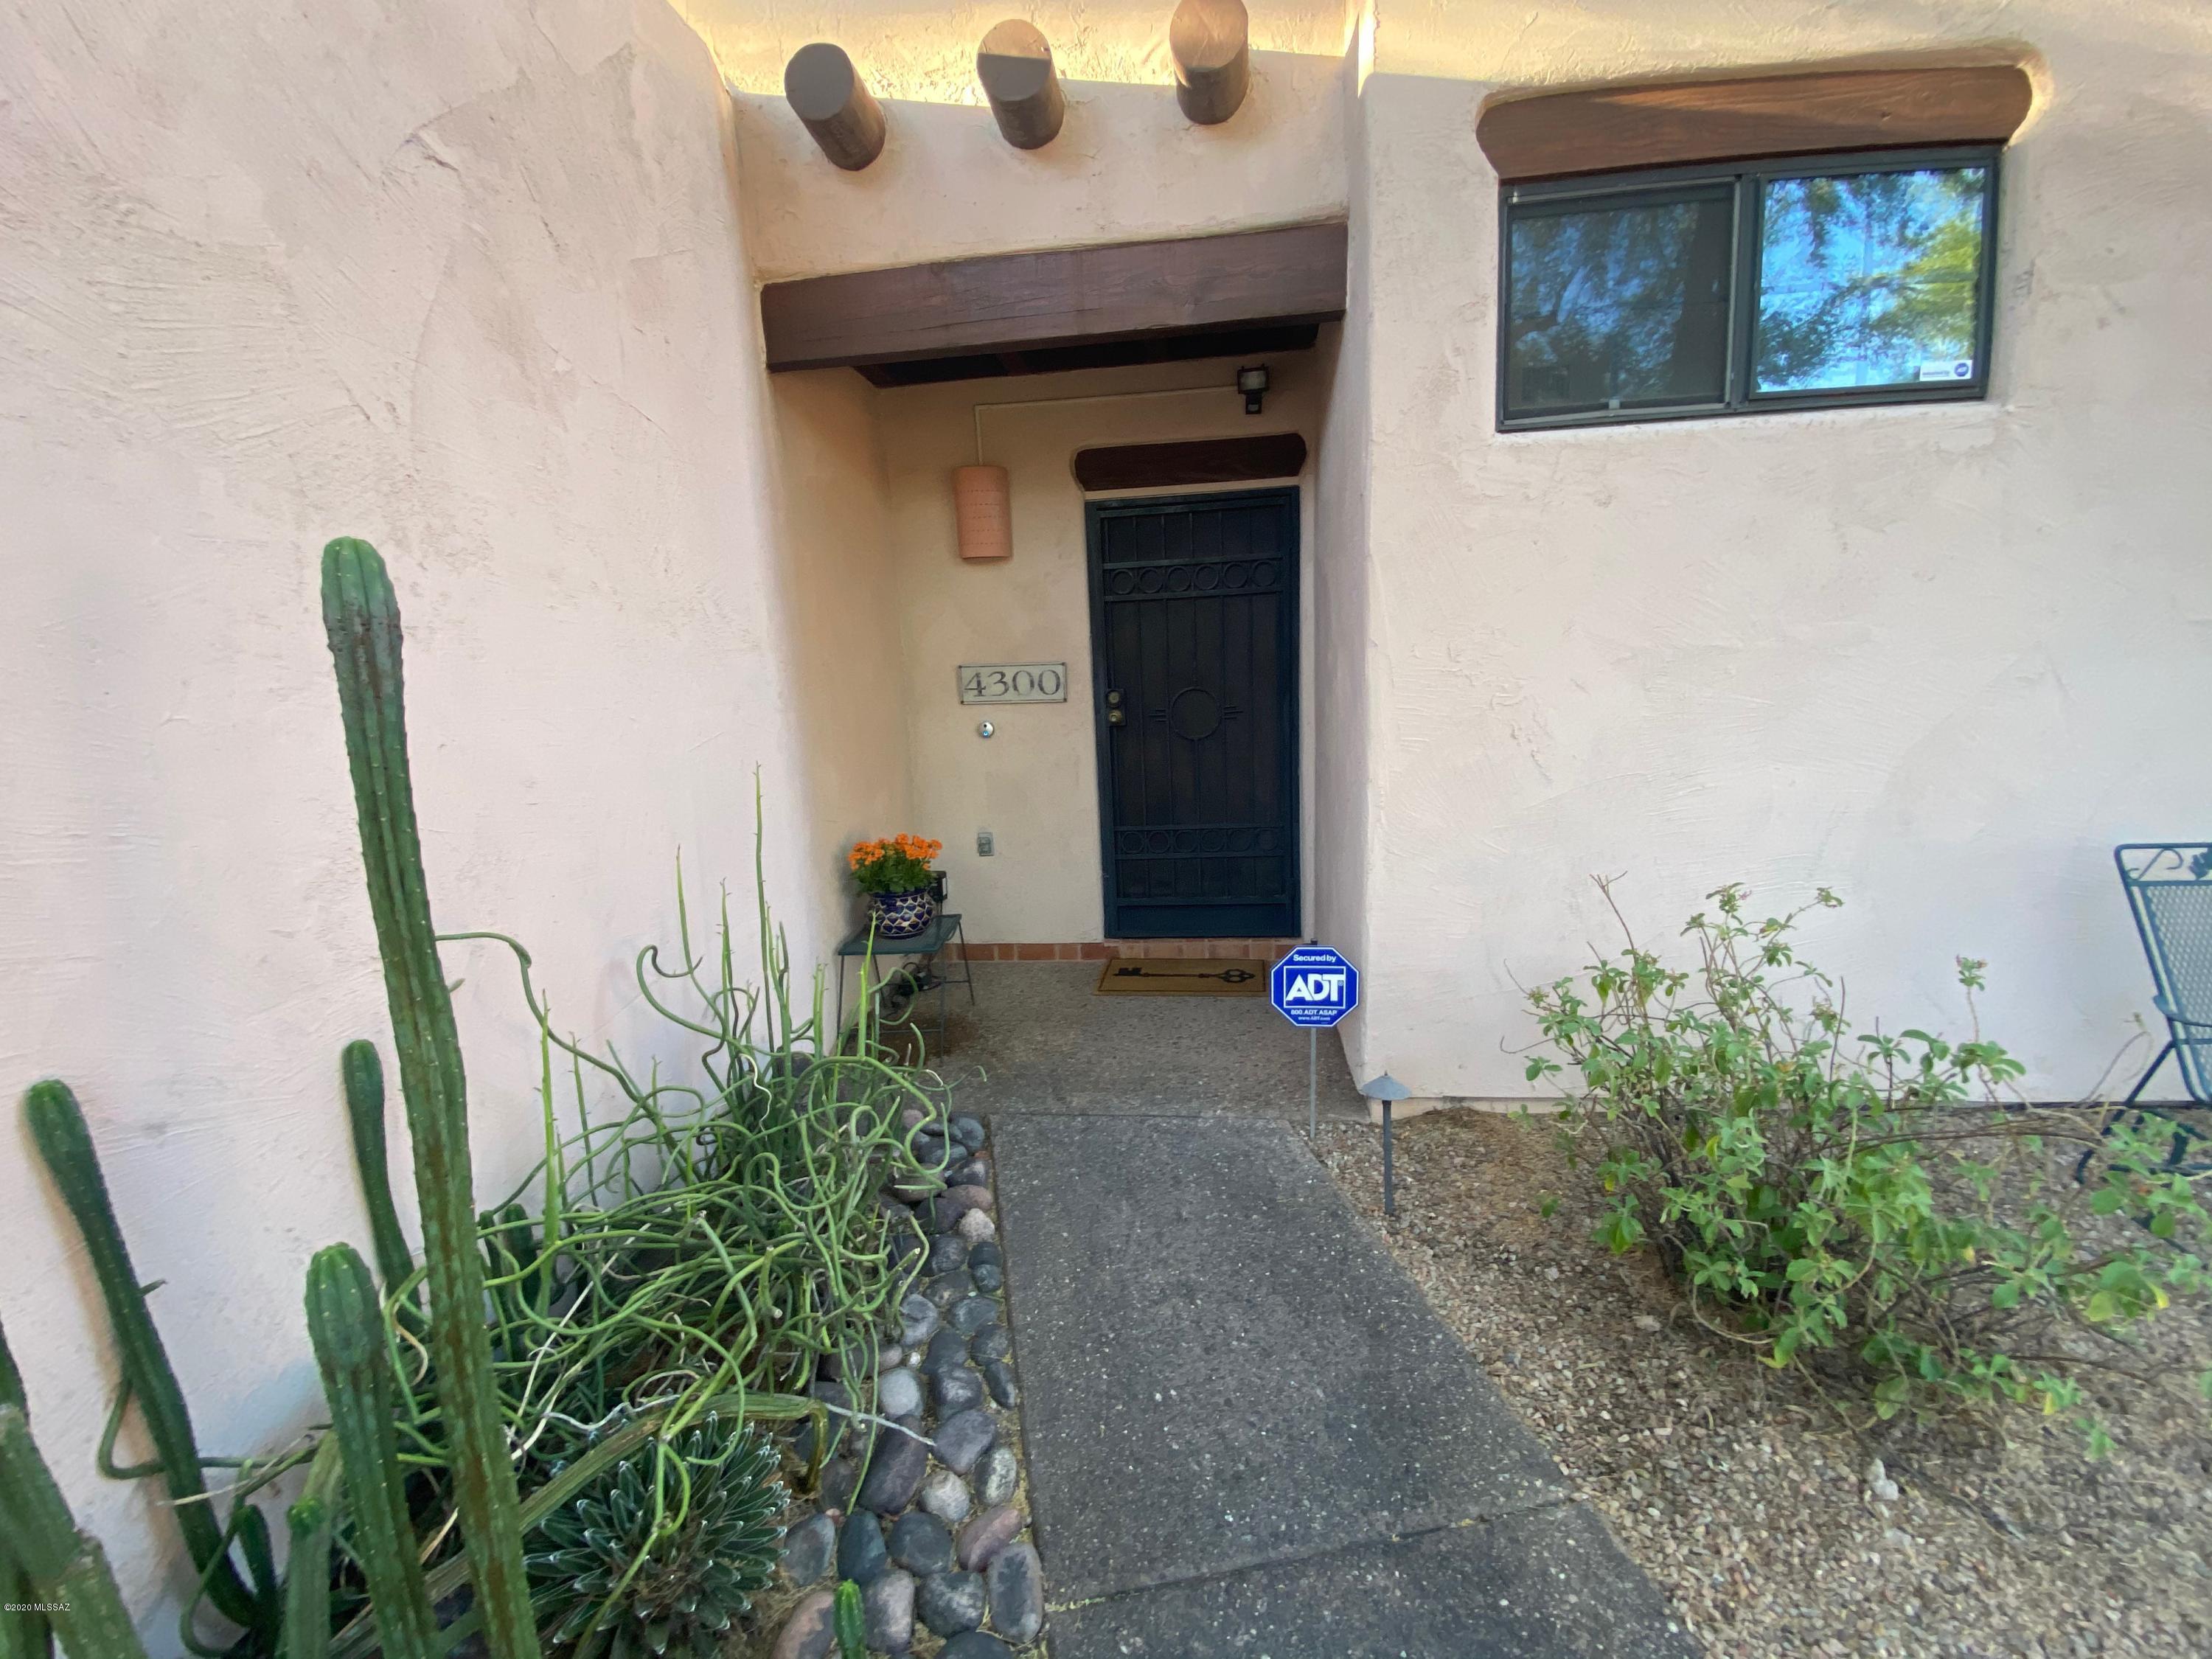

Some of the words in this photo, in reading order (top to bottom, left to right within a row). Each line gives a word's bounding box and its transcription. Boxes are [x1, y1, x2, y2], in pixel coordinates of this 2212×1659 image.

[964, 669, 1060, 697] 4300
[1326, 954, 1337, 963] by
[1285, 973, 1346, 1001] ADT
